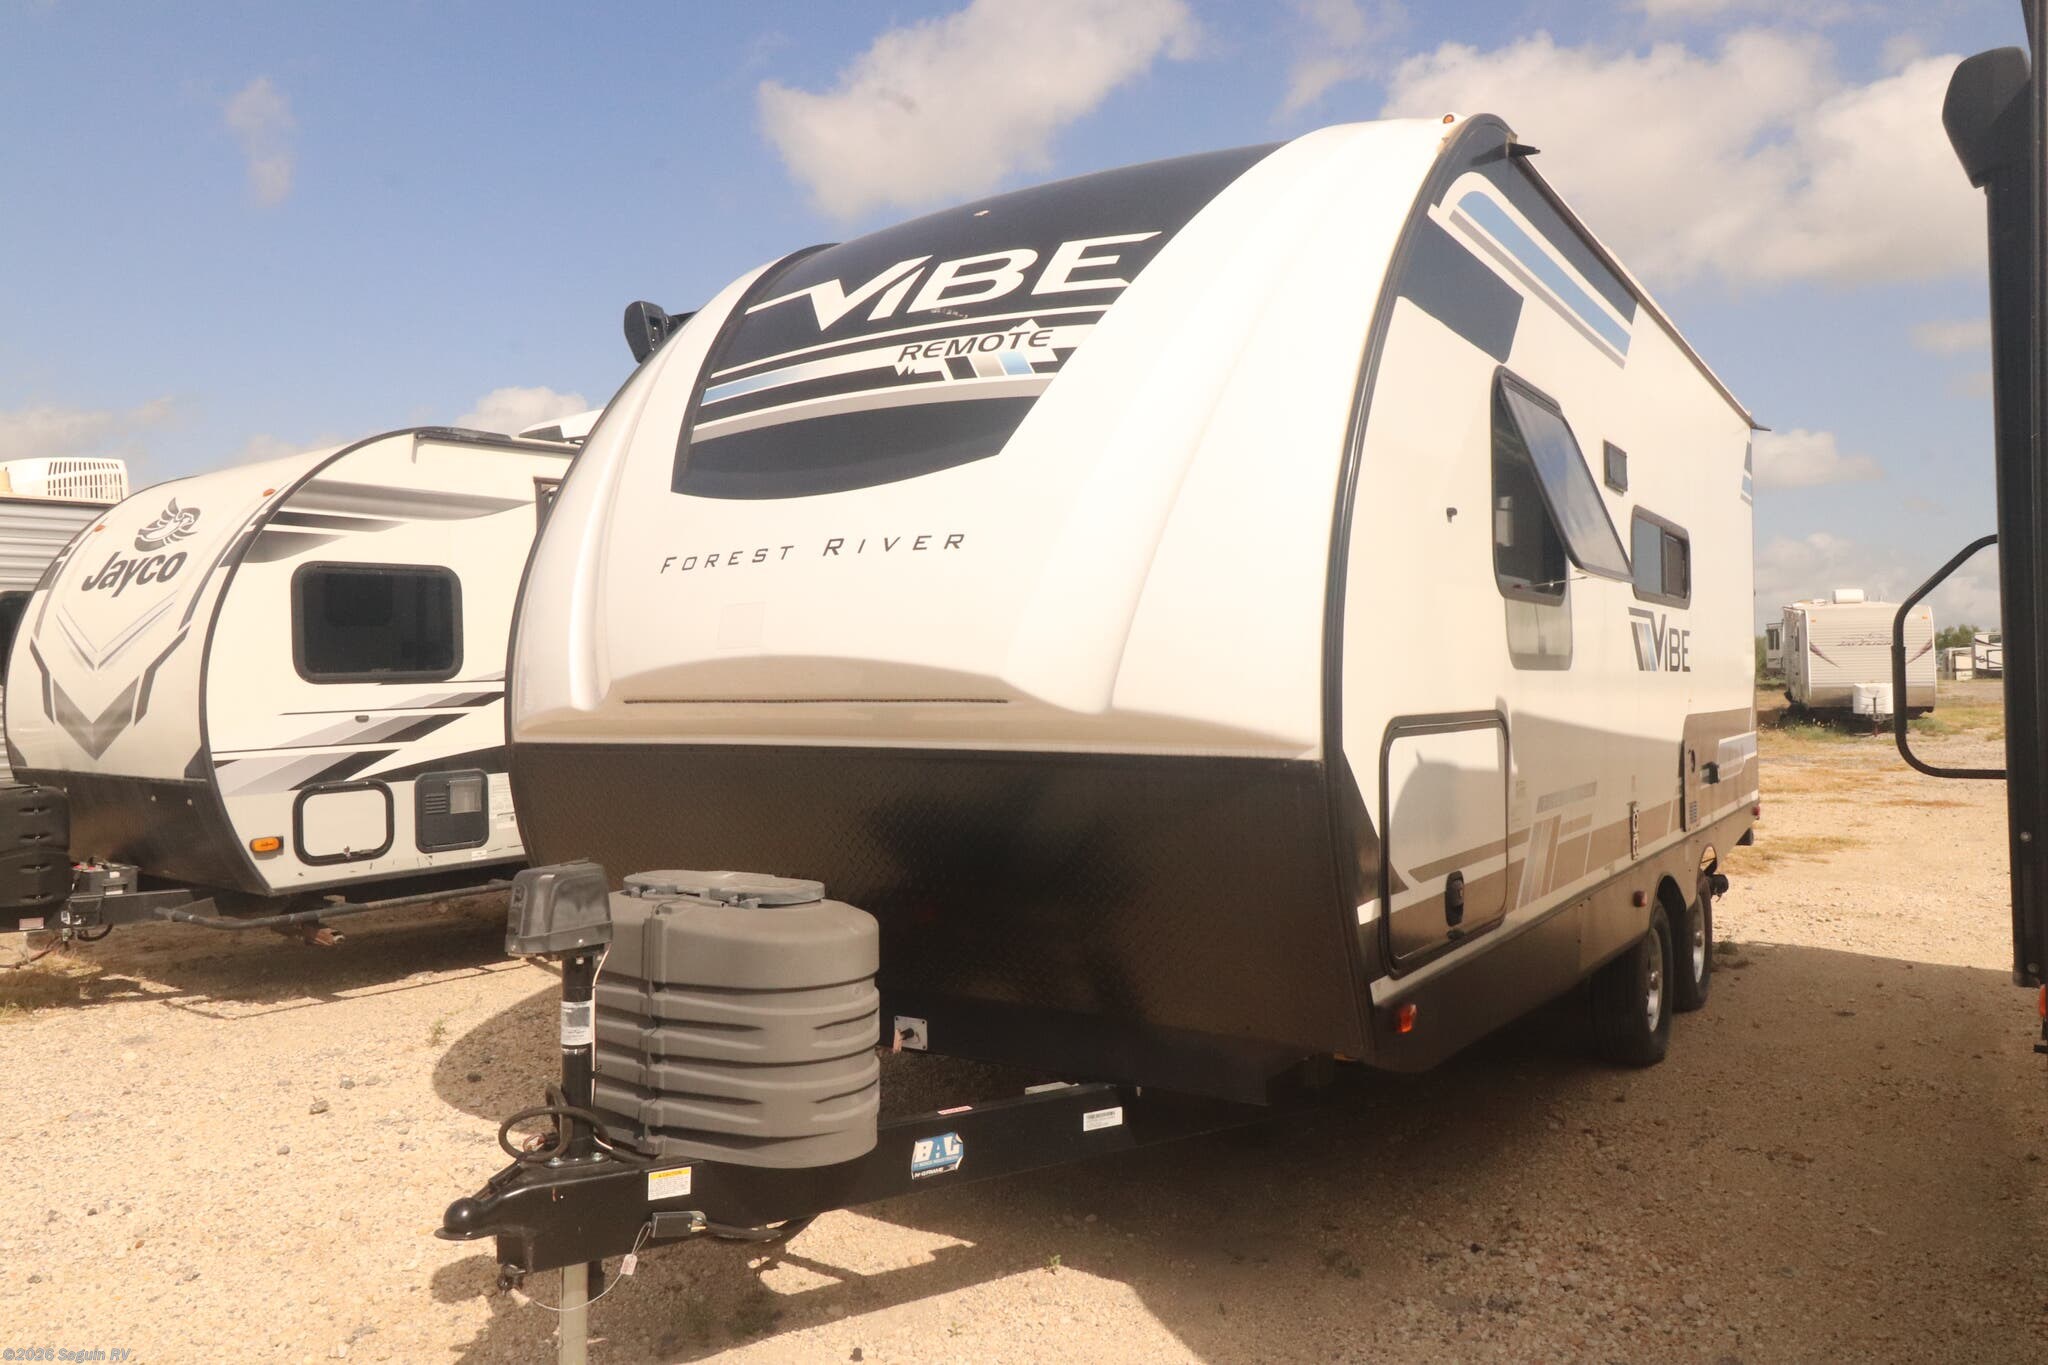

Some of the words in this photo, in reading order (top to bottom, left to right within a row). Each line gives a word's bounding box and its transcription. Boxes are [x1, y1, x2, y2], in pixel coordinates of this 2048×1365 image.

[745, 231, 1163, 332] VIBE
[897, 328, 1054, 364] REMOTE
[81, 551, 188, 598] Jayco
[660, 545, 795, 574] FOREST
[822, 533, 965, 557] RIVER
[1628, 606, 1691, 672] VIBE
